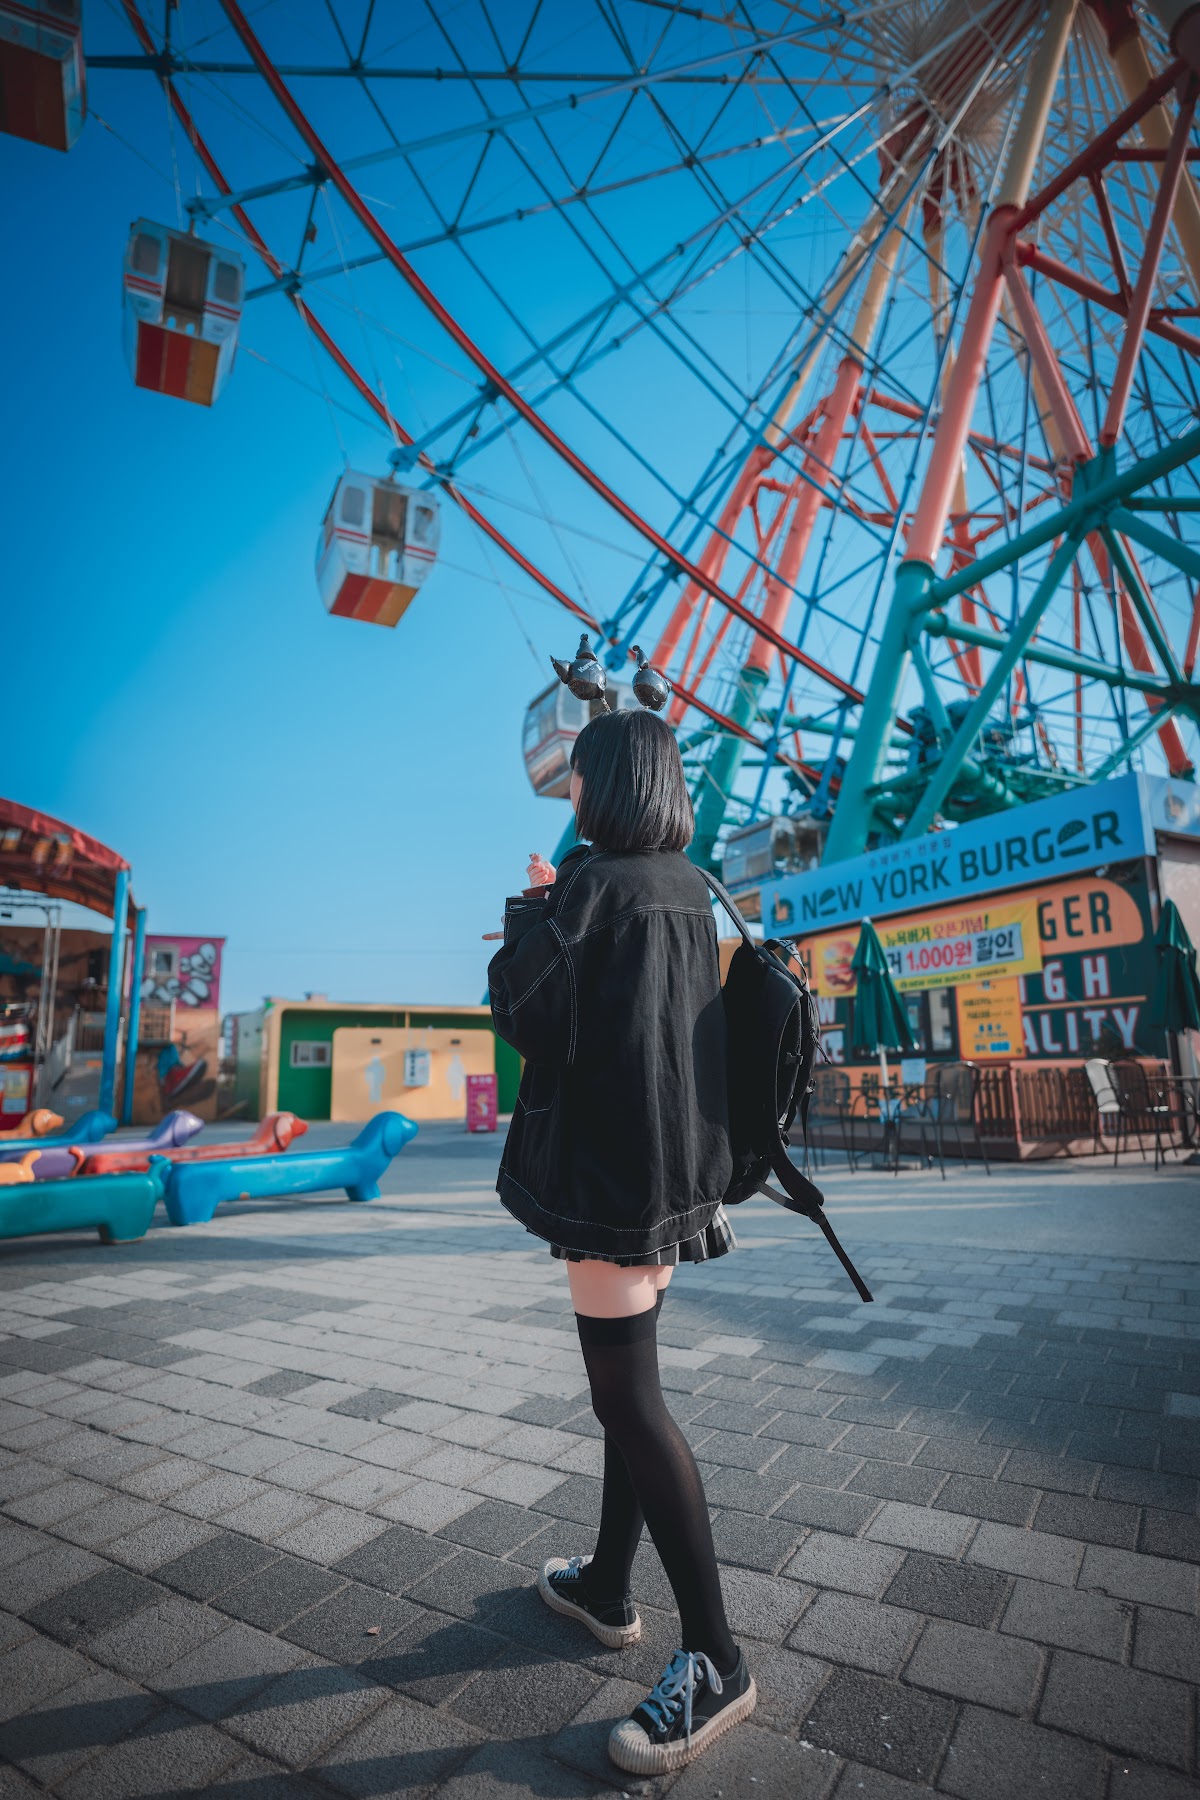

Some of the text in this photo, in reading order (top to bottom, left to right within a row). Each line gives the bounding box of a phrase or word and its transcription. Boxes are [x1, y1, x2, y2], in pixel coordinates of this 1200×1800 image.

[802, 810, 1123, 921] NEW YORK BURGER
[886, 914, 989, 947] 뉴욕버거 오픈기념!
[1039, 889, 1113, 941] GER
[906, 940, 972, 972] 1,000원
[976, 930, 1015, 963] 할인
